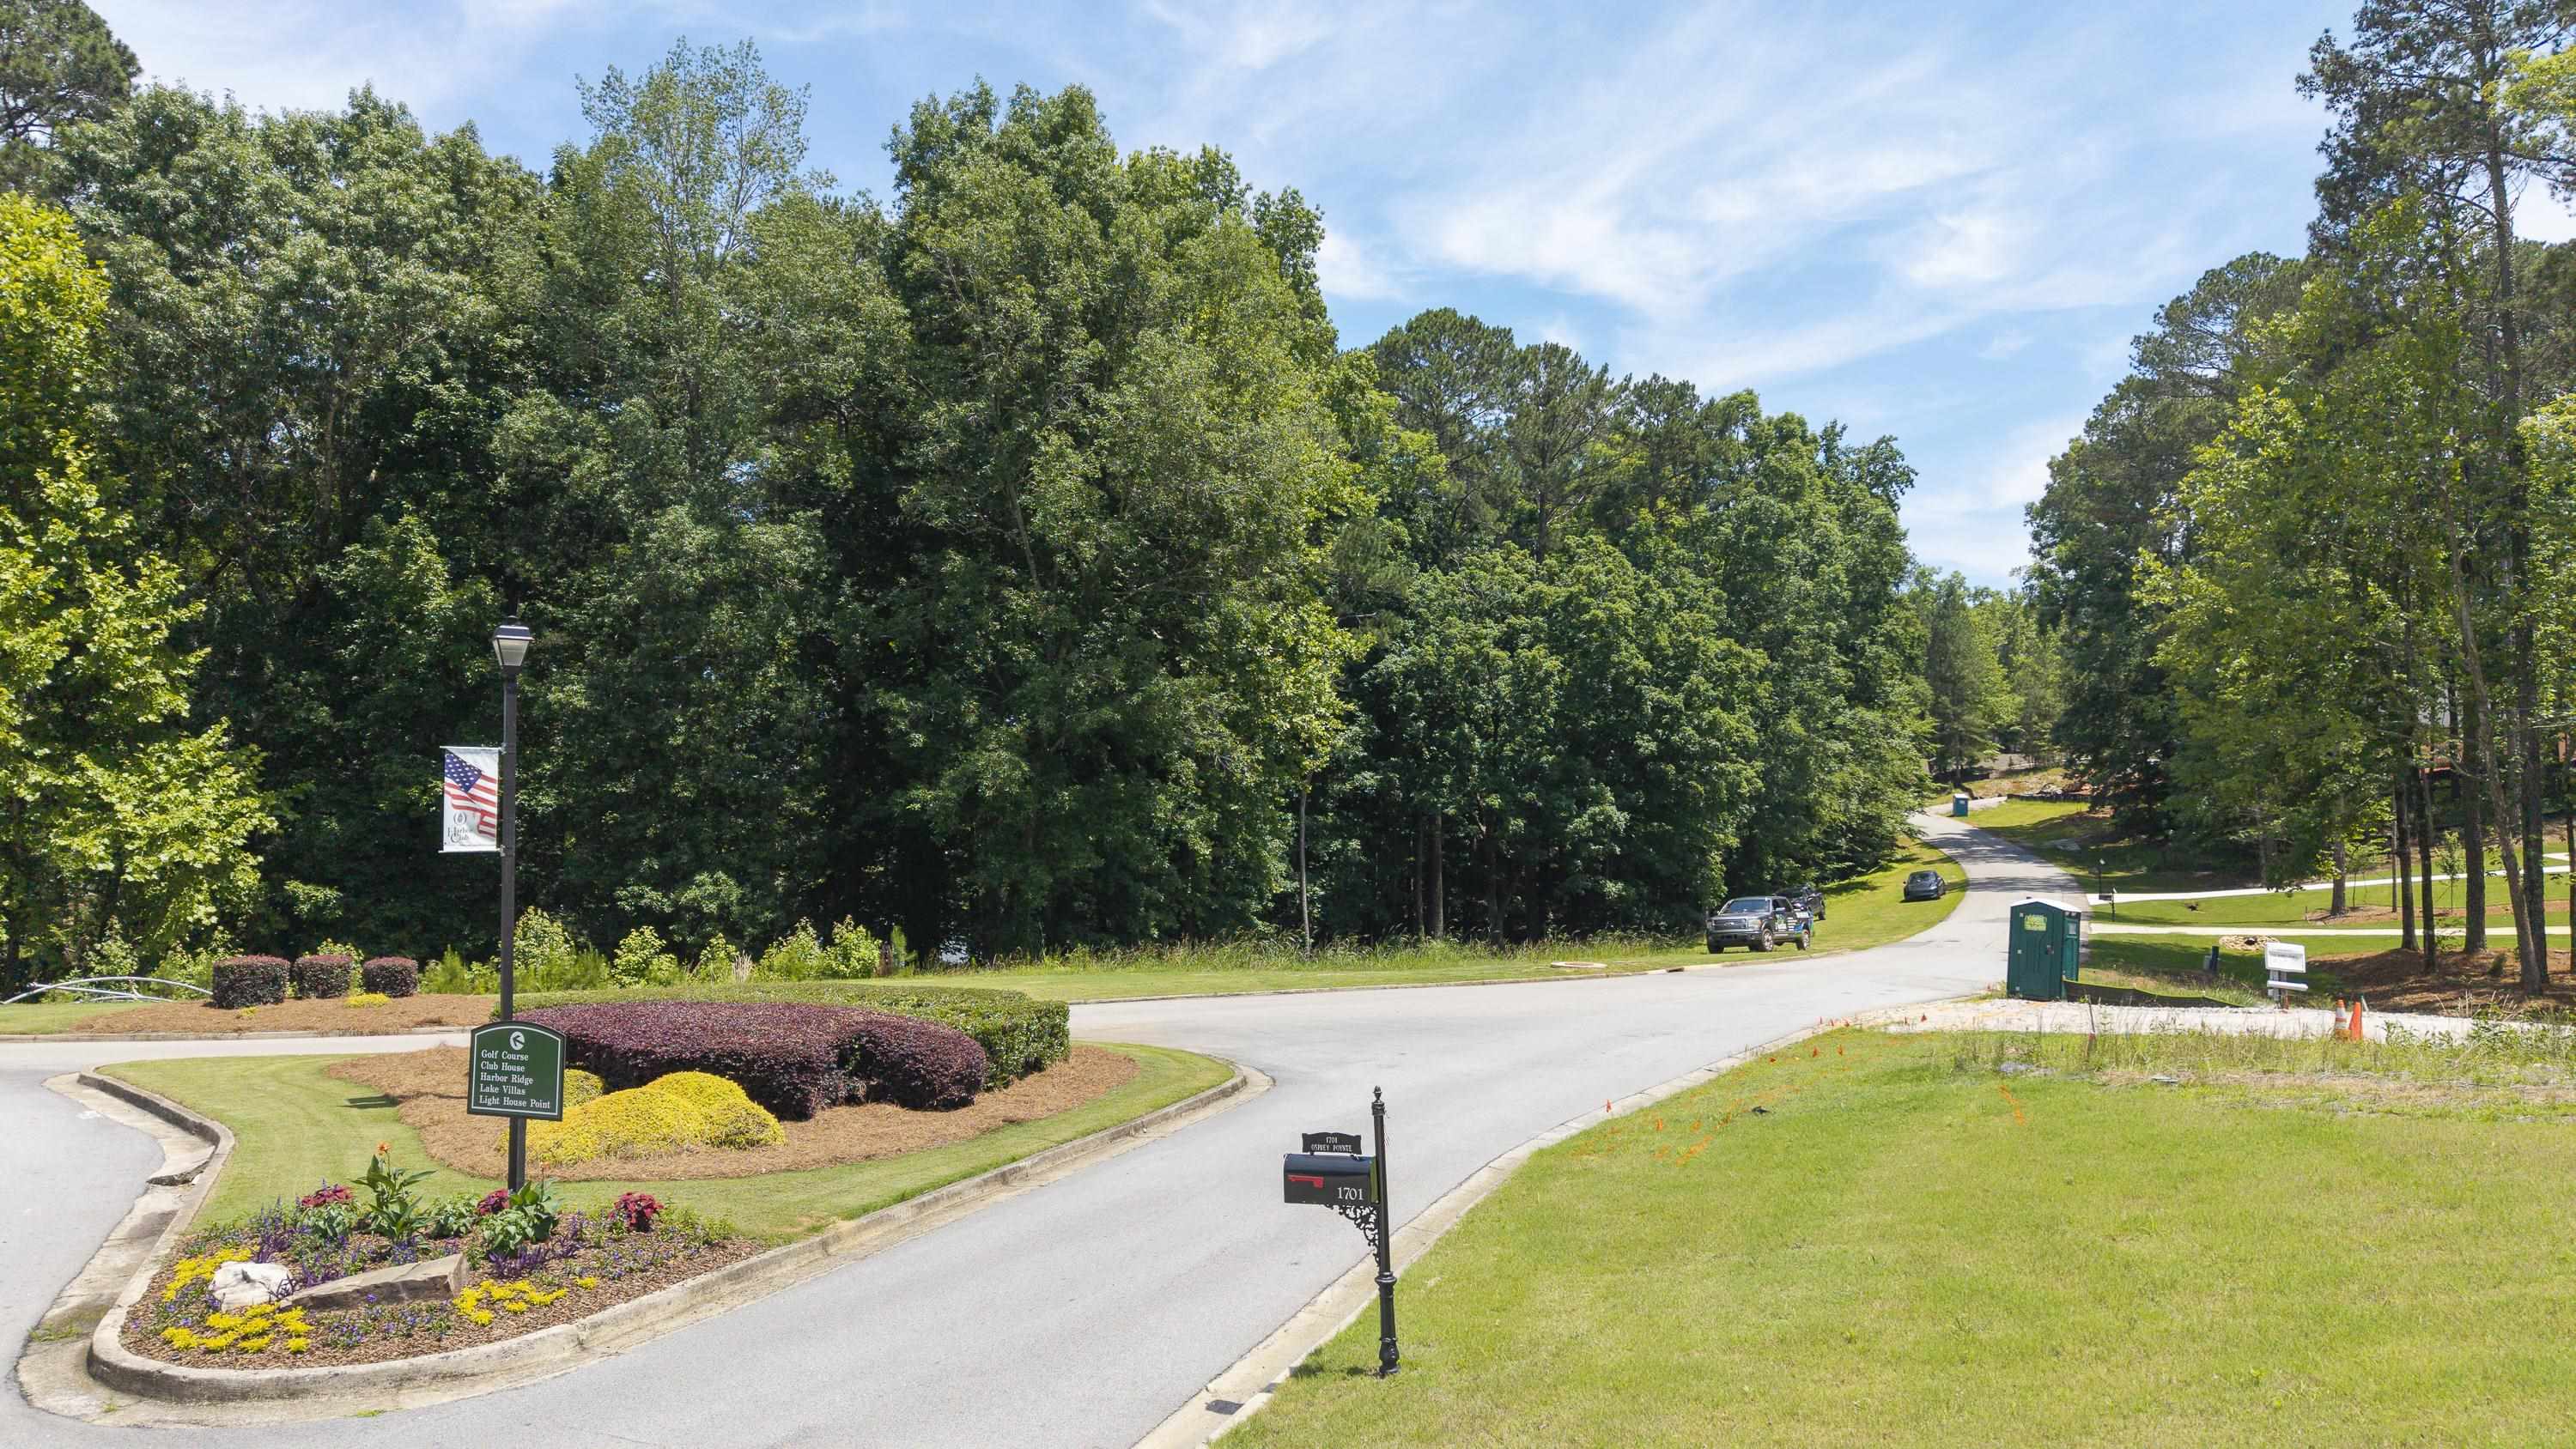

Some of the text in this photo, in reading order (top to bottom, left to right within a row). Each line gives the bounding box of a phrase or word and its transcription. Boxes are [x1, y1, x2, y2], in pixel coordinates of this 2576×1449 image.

[482, 1049, 529, 1061] Golf Course
[480, 1061, 526, 1072] Club House
[480, 1072, 534, 1085] Harbor Ridge
[480, 1083, 526, 1095] Lake Villas
[479, 1095, 550, 1108] Light House Point
[1337, 1187, 1364, 1200] 1701
